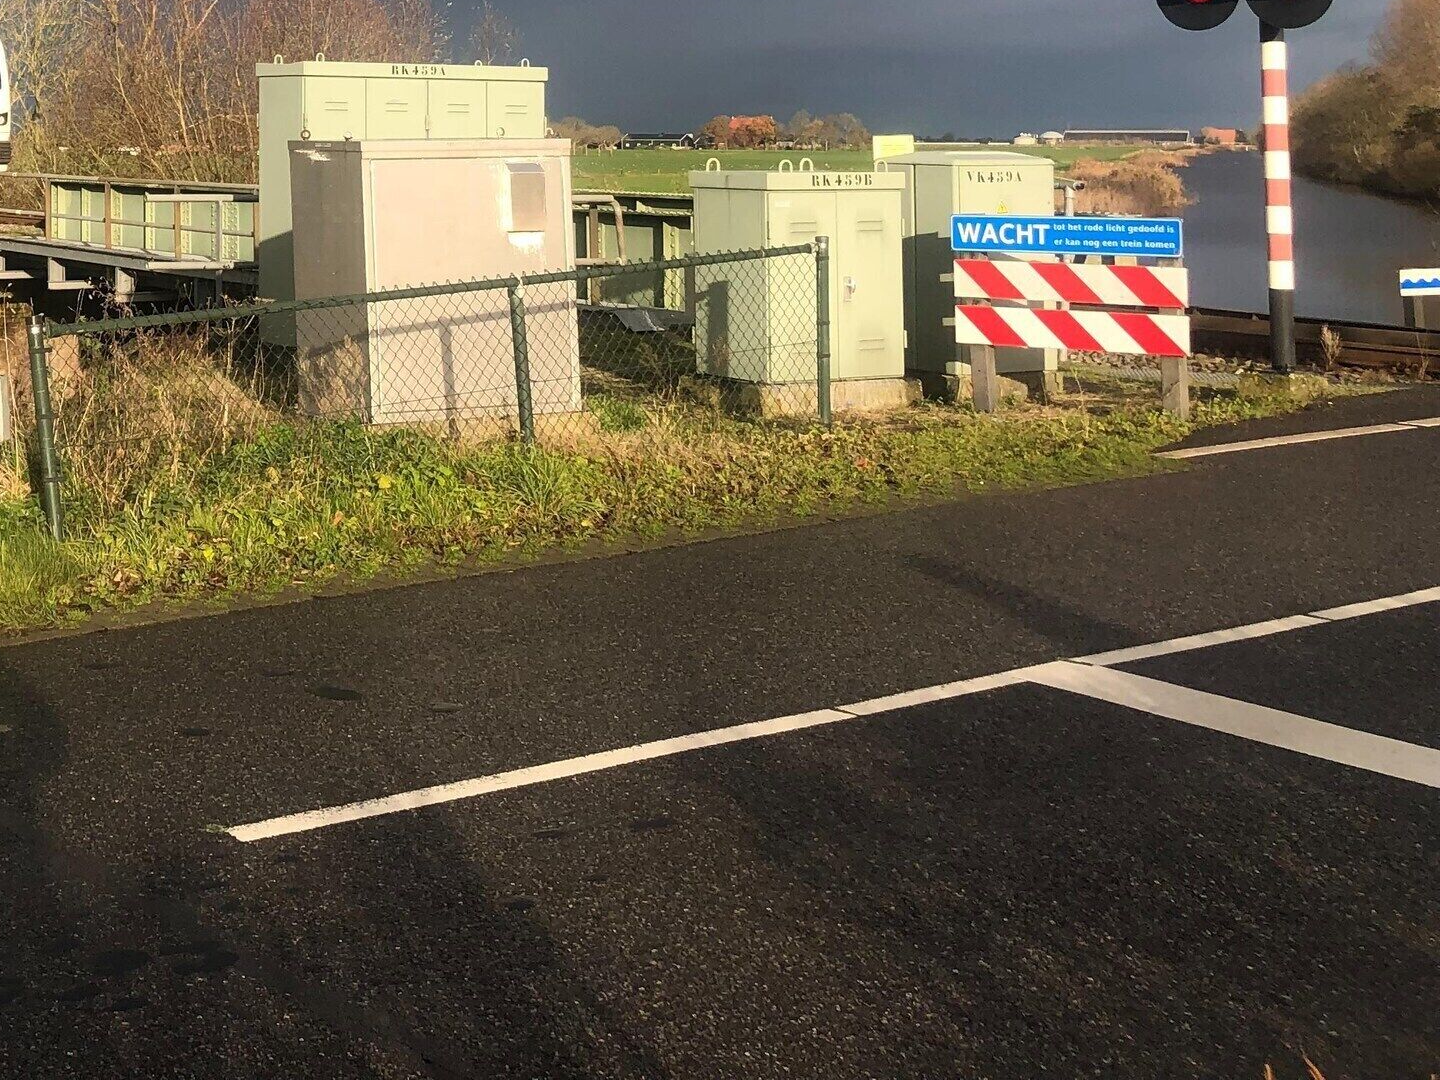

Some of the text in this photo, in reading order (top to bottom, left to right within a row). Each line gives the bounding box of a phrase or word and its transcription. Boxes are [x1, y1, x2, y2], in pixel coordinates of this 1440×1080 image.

[812, 174, 873, 187] RK459B
[967, 170, 1022, 183] VK459A
[957, 222, 1050, 245] WACHT
[1068, 223, 1081, 231] het
[1084, 224, 1103, 232] rode
[1106, 224, 1126, 233] licht
[1128, 224, 1164, 234] gedoofd
[1167, 225, 1175, 233] is
[1065, 238, 1080, 246] kan
[1083, 240, 1099, 248] nog
[1121, 240, 1142, 248] trein
[1145, 240, 1175, 249] komen
